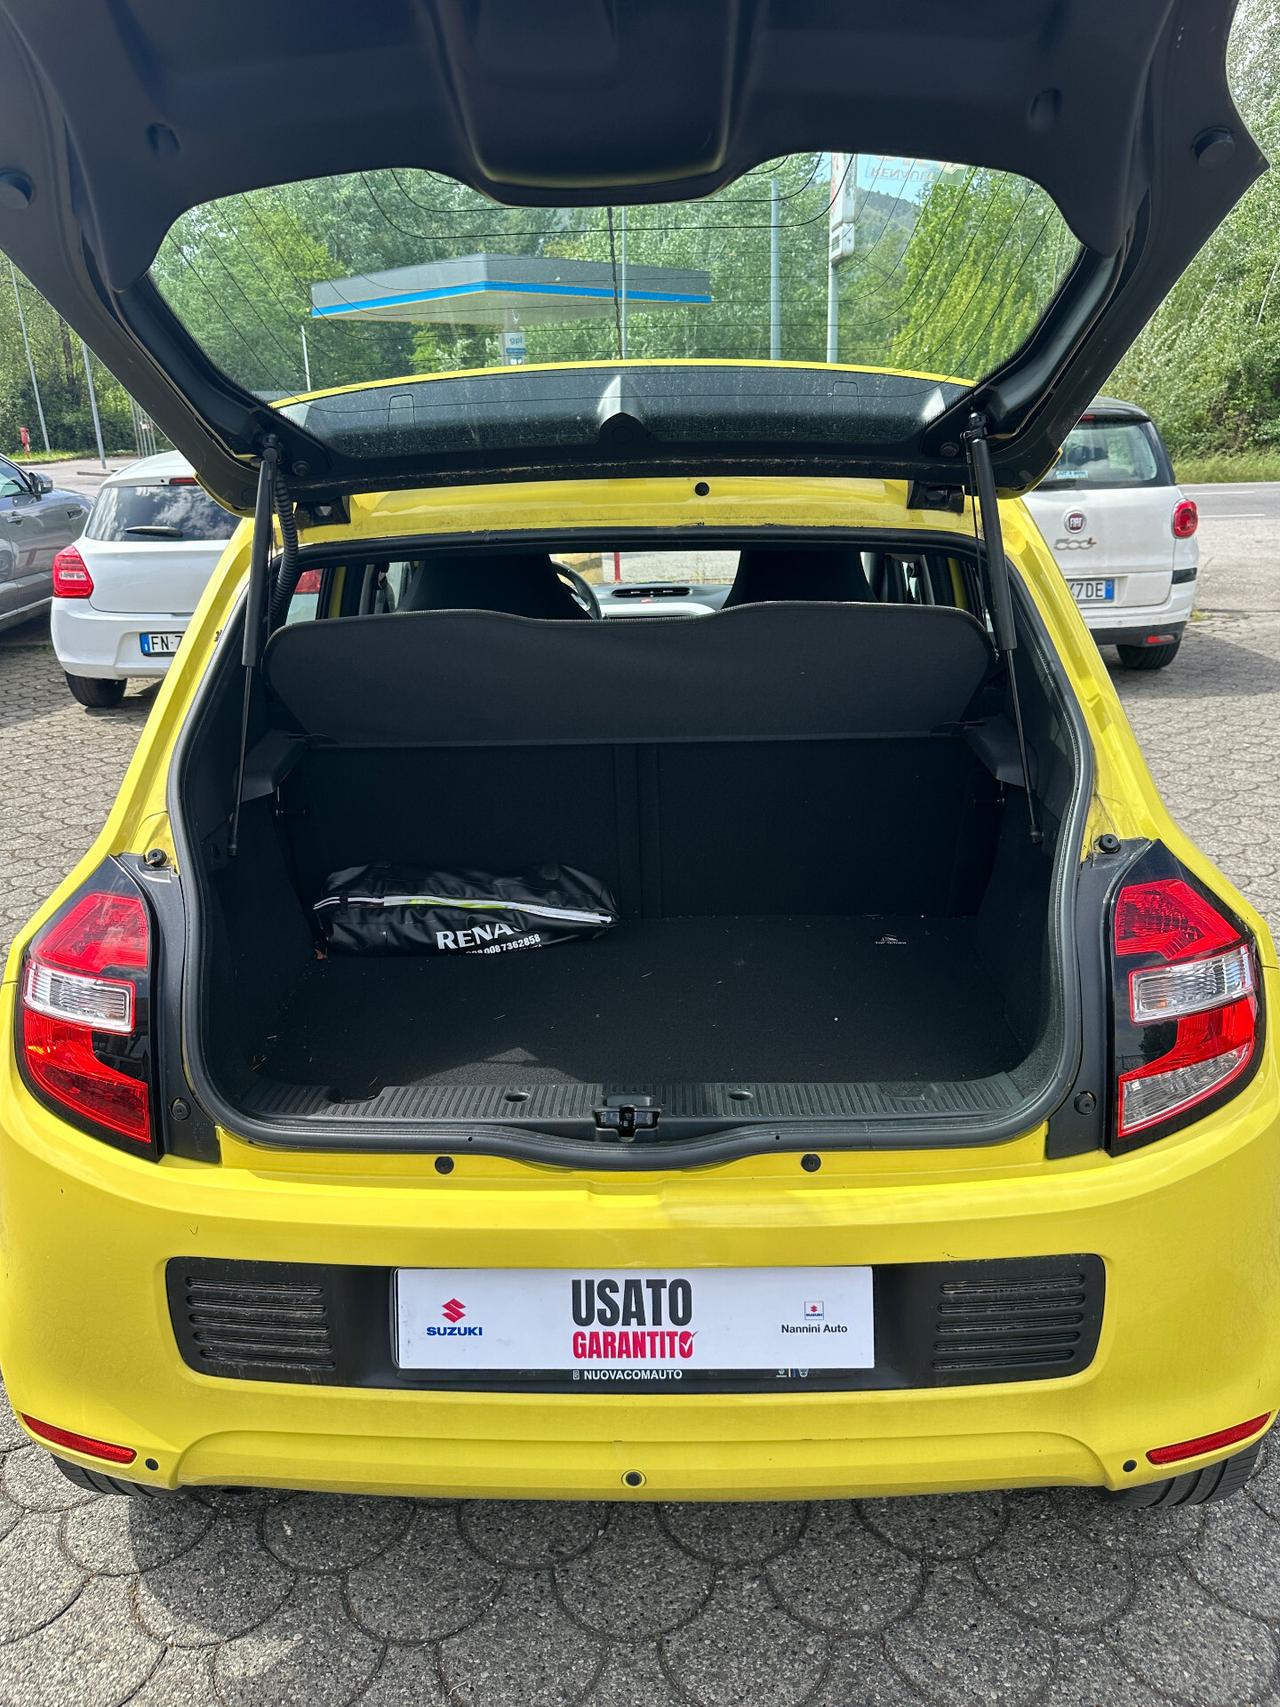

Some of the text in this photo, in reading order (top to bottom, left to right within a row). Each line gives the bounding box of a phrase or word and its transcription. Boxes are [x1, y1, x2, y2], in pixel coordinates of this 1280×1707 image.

[435, 923, 522, 949] RENA
[571, 1278, 692, 1326] USATO
[426, 1326, 483, 1336] SUZUKI
[781, 1324, 848, 1334] Nannini Auto
[572, 1330, 696, 1359] GARANTITO
[583, 1369, 683, 1380] NUOVACOMAUTO
